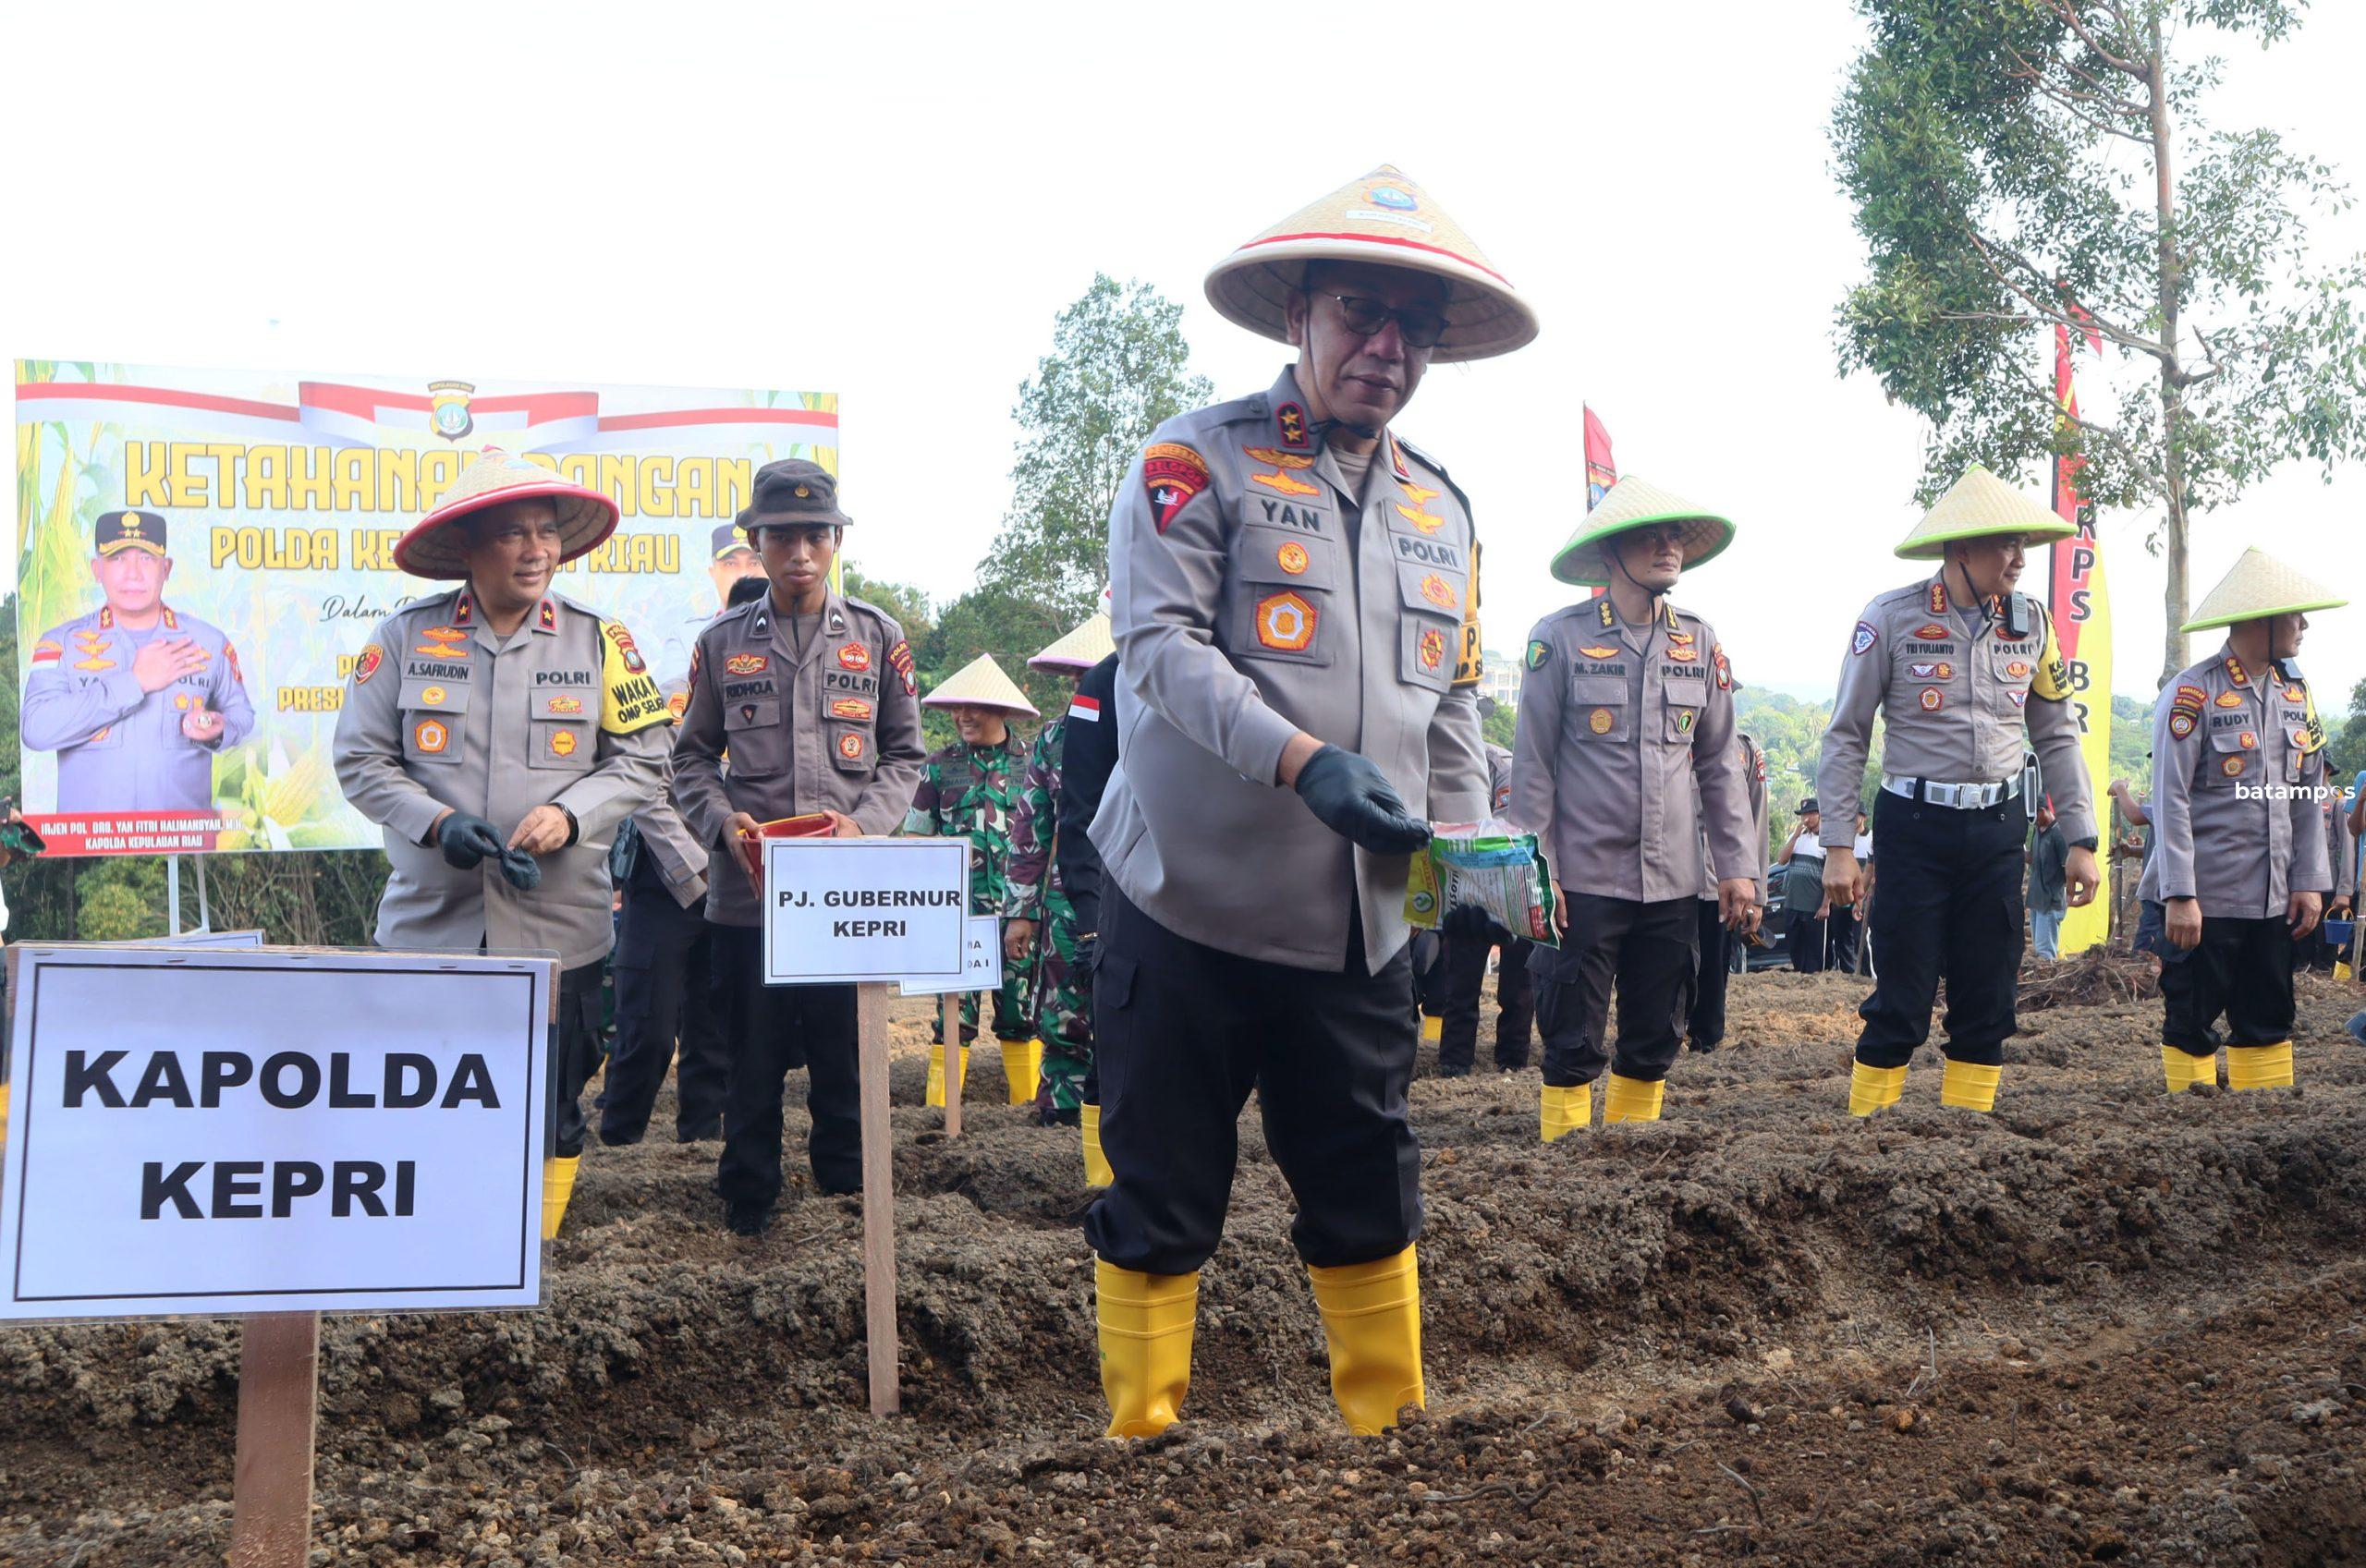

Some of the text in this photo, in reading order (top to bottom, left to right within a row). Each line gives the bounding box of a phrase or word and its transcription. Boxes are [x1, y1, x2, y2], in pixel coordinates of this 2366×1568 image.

[125, 441, 479, 514] KETAHANA
[1261, 499, 1321, 532] YAN
[210, 526, 339, 570] POLDA
[588, 533, 681, 573] RIAU
[1397, 537, 1458, 569] POLRI
[319, 594, 391, 623] Dalam
[1993, 644, 2031, 655] POLRI
[408, 662, 470, 681] A.SAFRUDIN
[1574, 662, 1627, 675] M. ZAKIR
[1661, 664, 1705, 678] POLRI
[177, 675, 211, 690] OLRI
[535, 671, 591, 686] POLRI
[827, 673, 878, 694] POLRI
[277, 686, 346, 711] PRESI
[2213, 713, 2250, 728] RUDY
[2283, 711, 2307, 722] POL
[41, 822, 68, 836] IRJEN
[116, 820, 133, 834] YAN
[135, 820, 158, 833] FITRI
[85, 834, 203, 851] KAPOLDA KEPULAUAN RIAU
[778, 890, 961, 907] PJ. GUBERNUR
[833, 920, 907, 938] KEPRI
[62, 1050, 502, 1109] KAPOLDA
[140, 1160, 416, 1220] KEPRI
